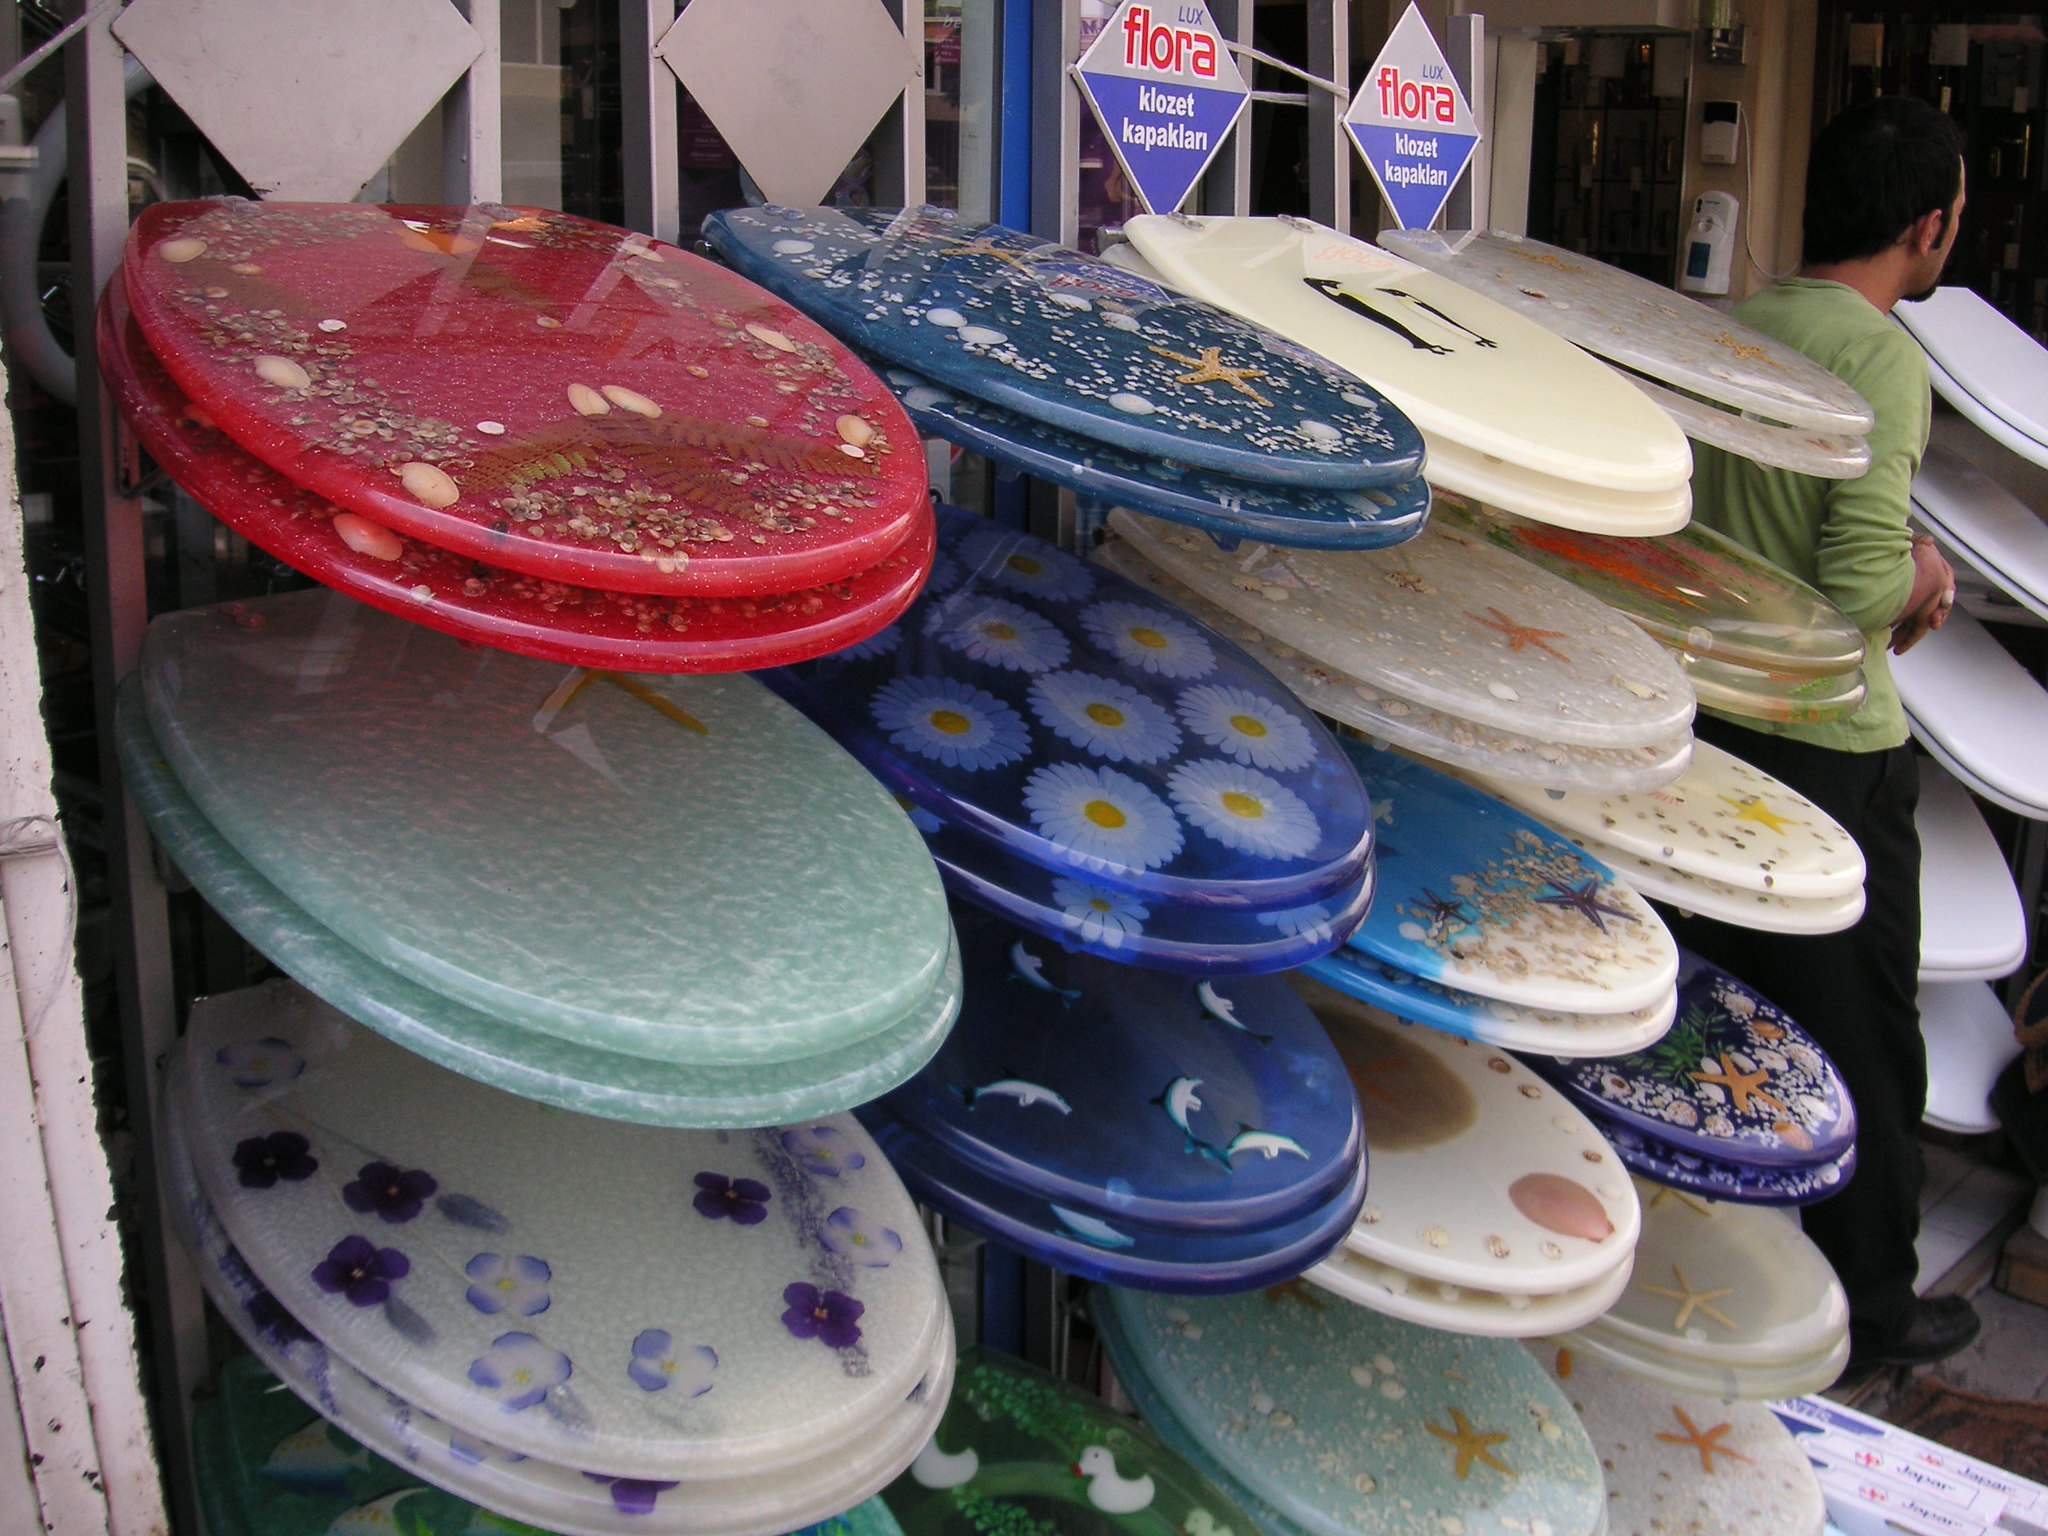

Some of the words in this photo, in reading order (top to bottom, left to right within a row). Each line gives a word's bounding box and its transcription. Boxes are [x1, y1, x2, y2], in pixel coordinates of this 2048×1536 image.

[1178, 6, 1204, 25] LUX
[1123, 6, 1217, 79] flora
[1422, 64, 1444, 80] LUX
[1139, 85, 1194, 117] klozet
[1377, 67, 1455, 123] flora
[1122, 117, 1208, 151] kapakları
[1395, 132, 1438, 158] klozet
[1385, 160, 1447, 188] kapakları
